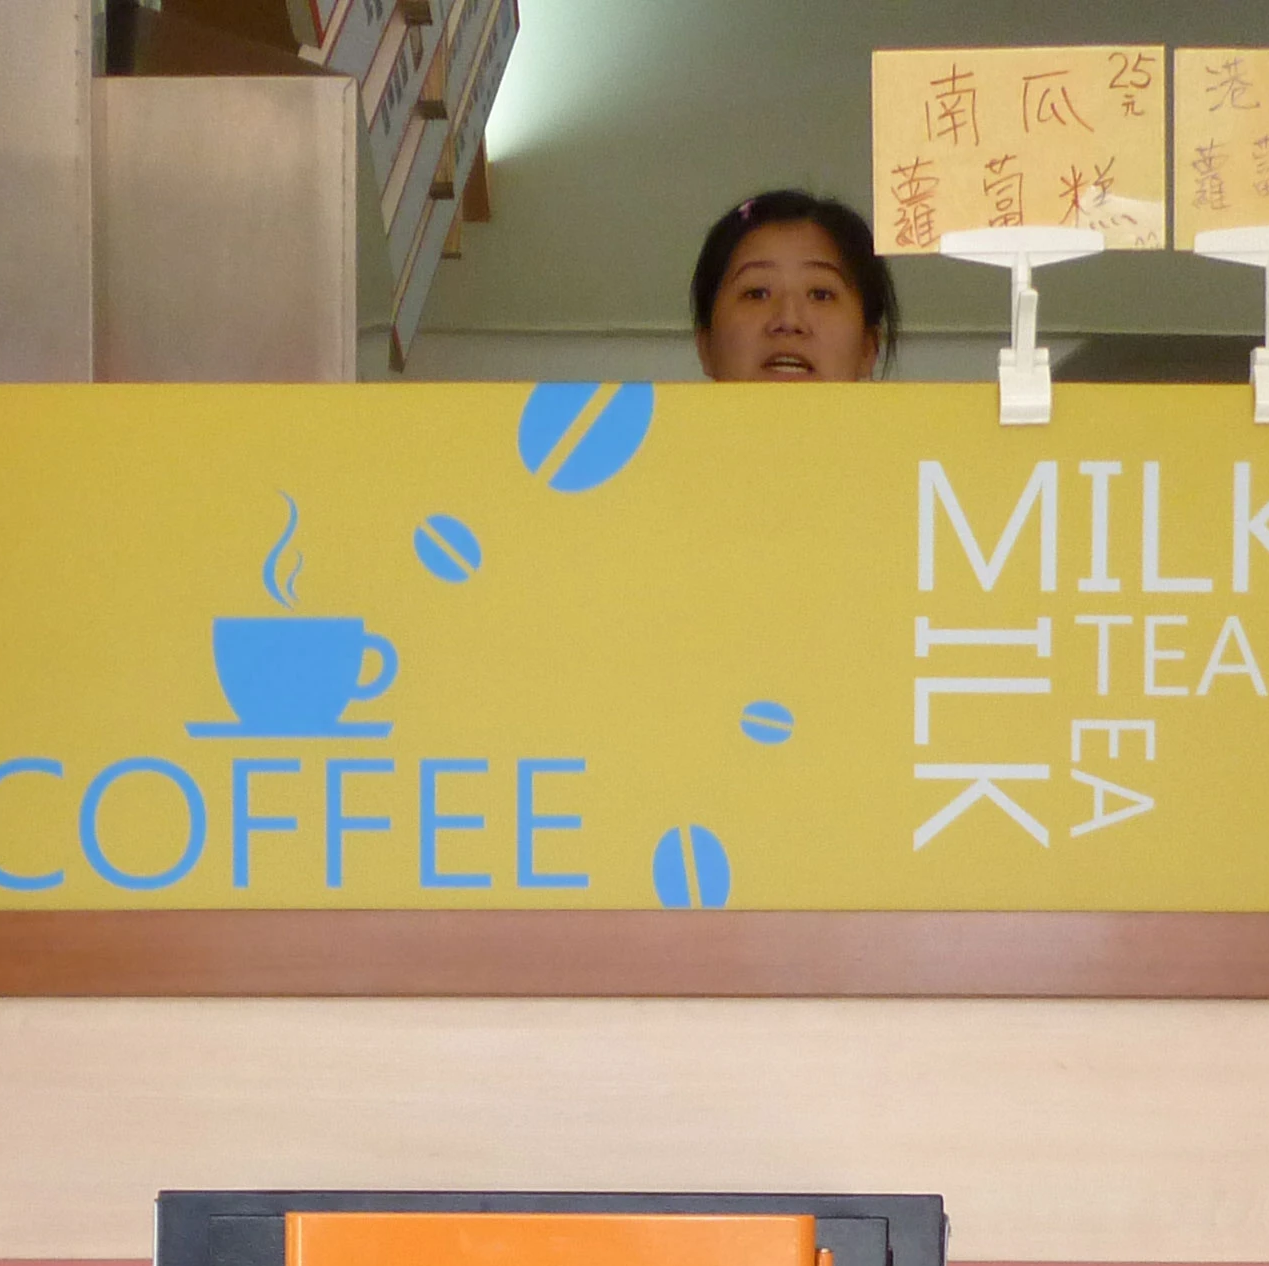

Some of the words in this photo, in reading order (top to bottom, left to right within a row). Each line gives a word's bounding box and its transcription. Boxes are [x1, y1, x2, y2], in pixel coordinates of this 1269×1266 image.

[925, 63, 1095, 147] 南瓜
[1107, 52, 1156, 91] 25
[1073, 614, 1269, 697] TEA
